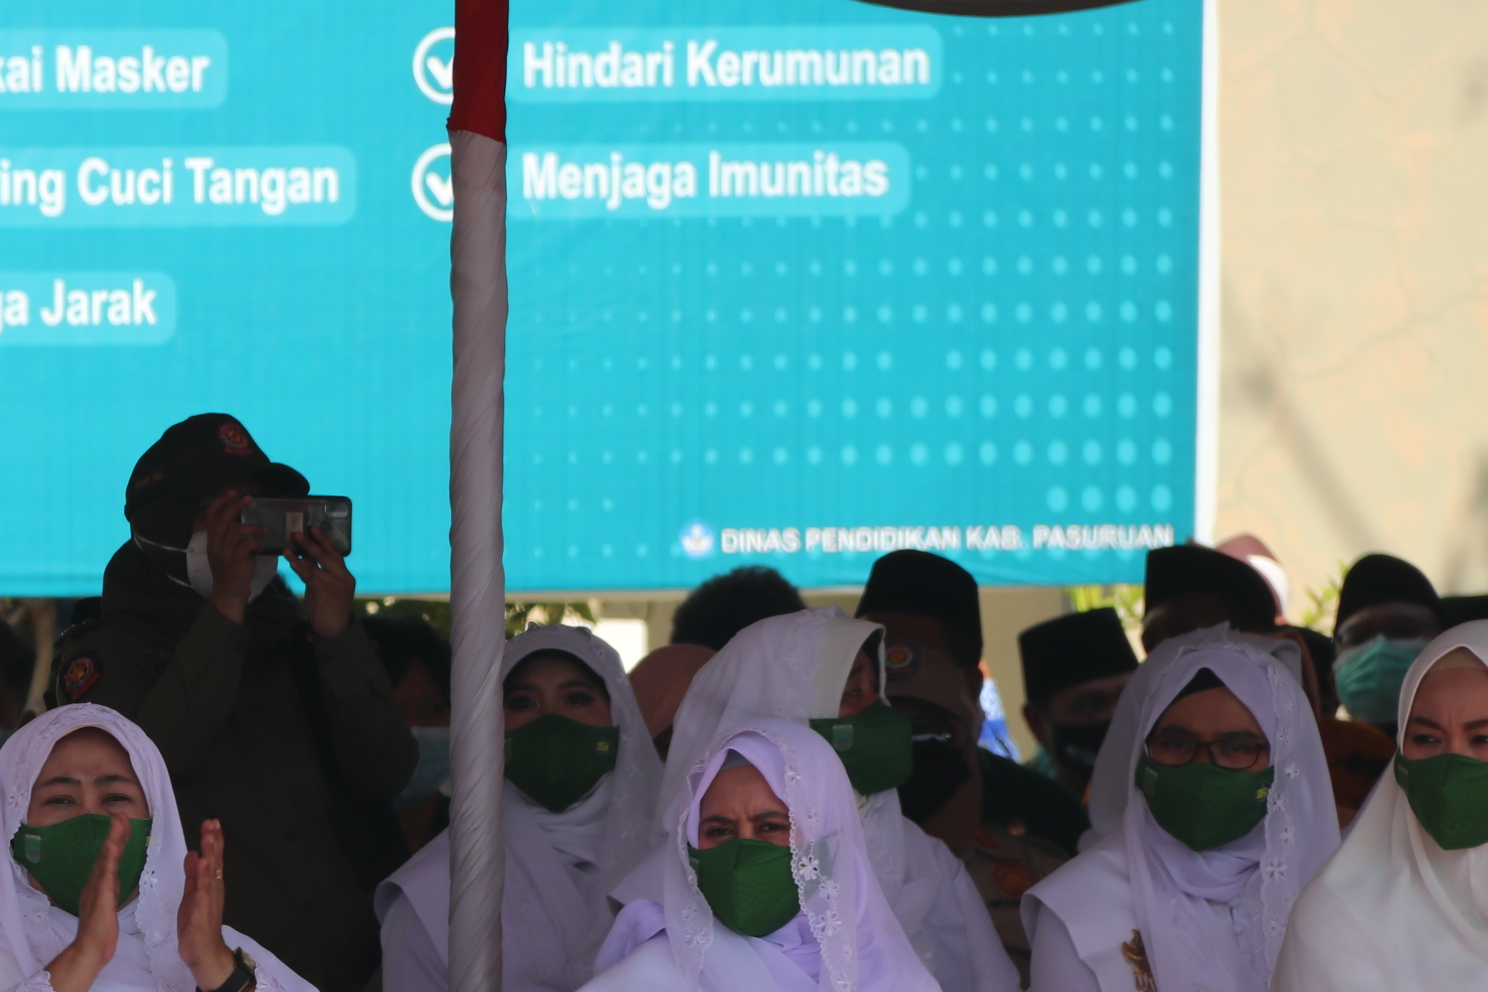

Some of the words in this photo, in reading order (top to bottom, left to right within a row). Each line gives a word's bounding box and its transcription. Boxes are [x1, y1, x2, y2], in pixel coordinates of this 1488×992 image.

[55, 45, 211, 93] Masker
[523, 40, 675, 89] Hindari
[686, 40, 930, 88] Kerumunan
[76, 157, 174, 206] Cuci
[183, 157, 340, 216] Tangan
[522, 152, 698, 211] Menjaga
[708, 150, 890, 198] Imunitas
[40, 279, 158, 326] Jarak
[720, 526, 802, 553] DINAS
[805, 525, 961, 553] PENDIDIKAN
[1032, 523, 1175, 552] PASURUAN
